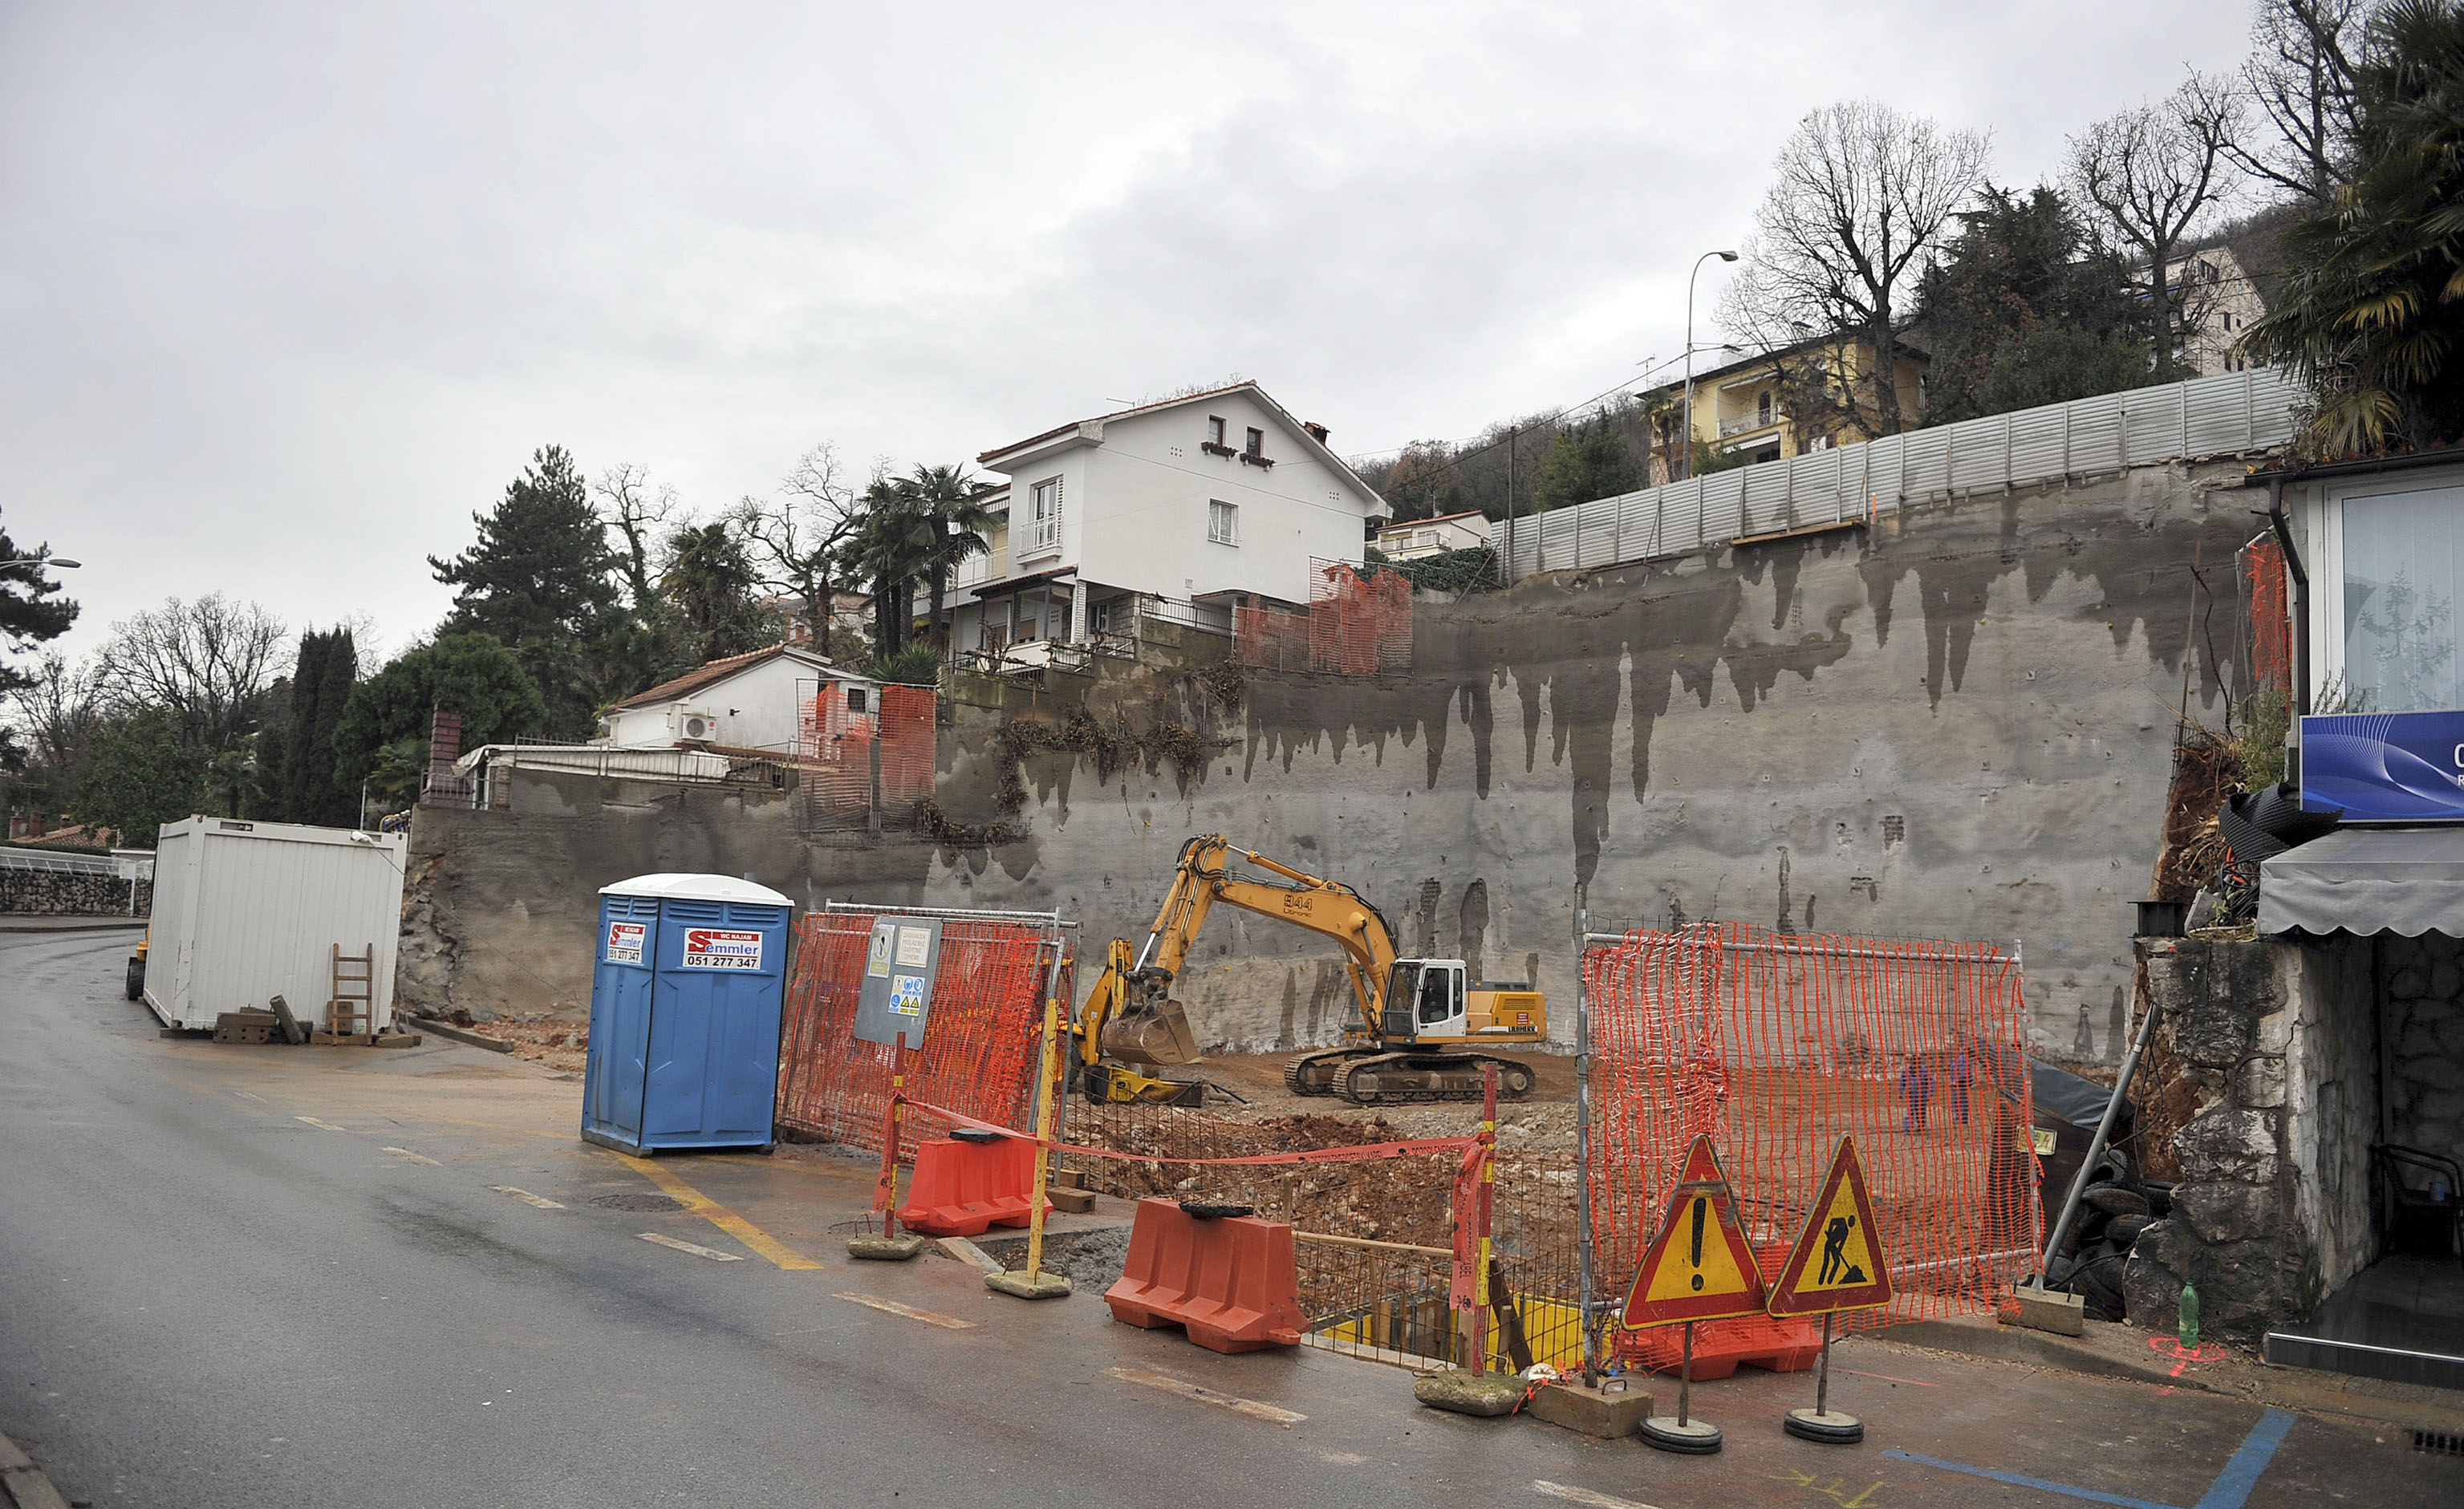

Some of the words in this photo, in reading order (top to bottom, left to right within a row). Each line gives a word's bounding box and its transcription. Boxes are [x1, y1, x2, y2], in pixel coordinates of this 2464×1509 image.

[1284, 894, 1313, 911] 944
[688, 931, 758, 955] Semmler
[618, 950, 627, 960] 277
[628, 951, 640, 962] 347
[687, 956, 708, 966] 051
[712, 957, 733, 967] 277
[737, 959, 757, 968] 347
[1508, 1025, 1536, 1033] LIEBHERR
